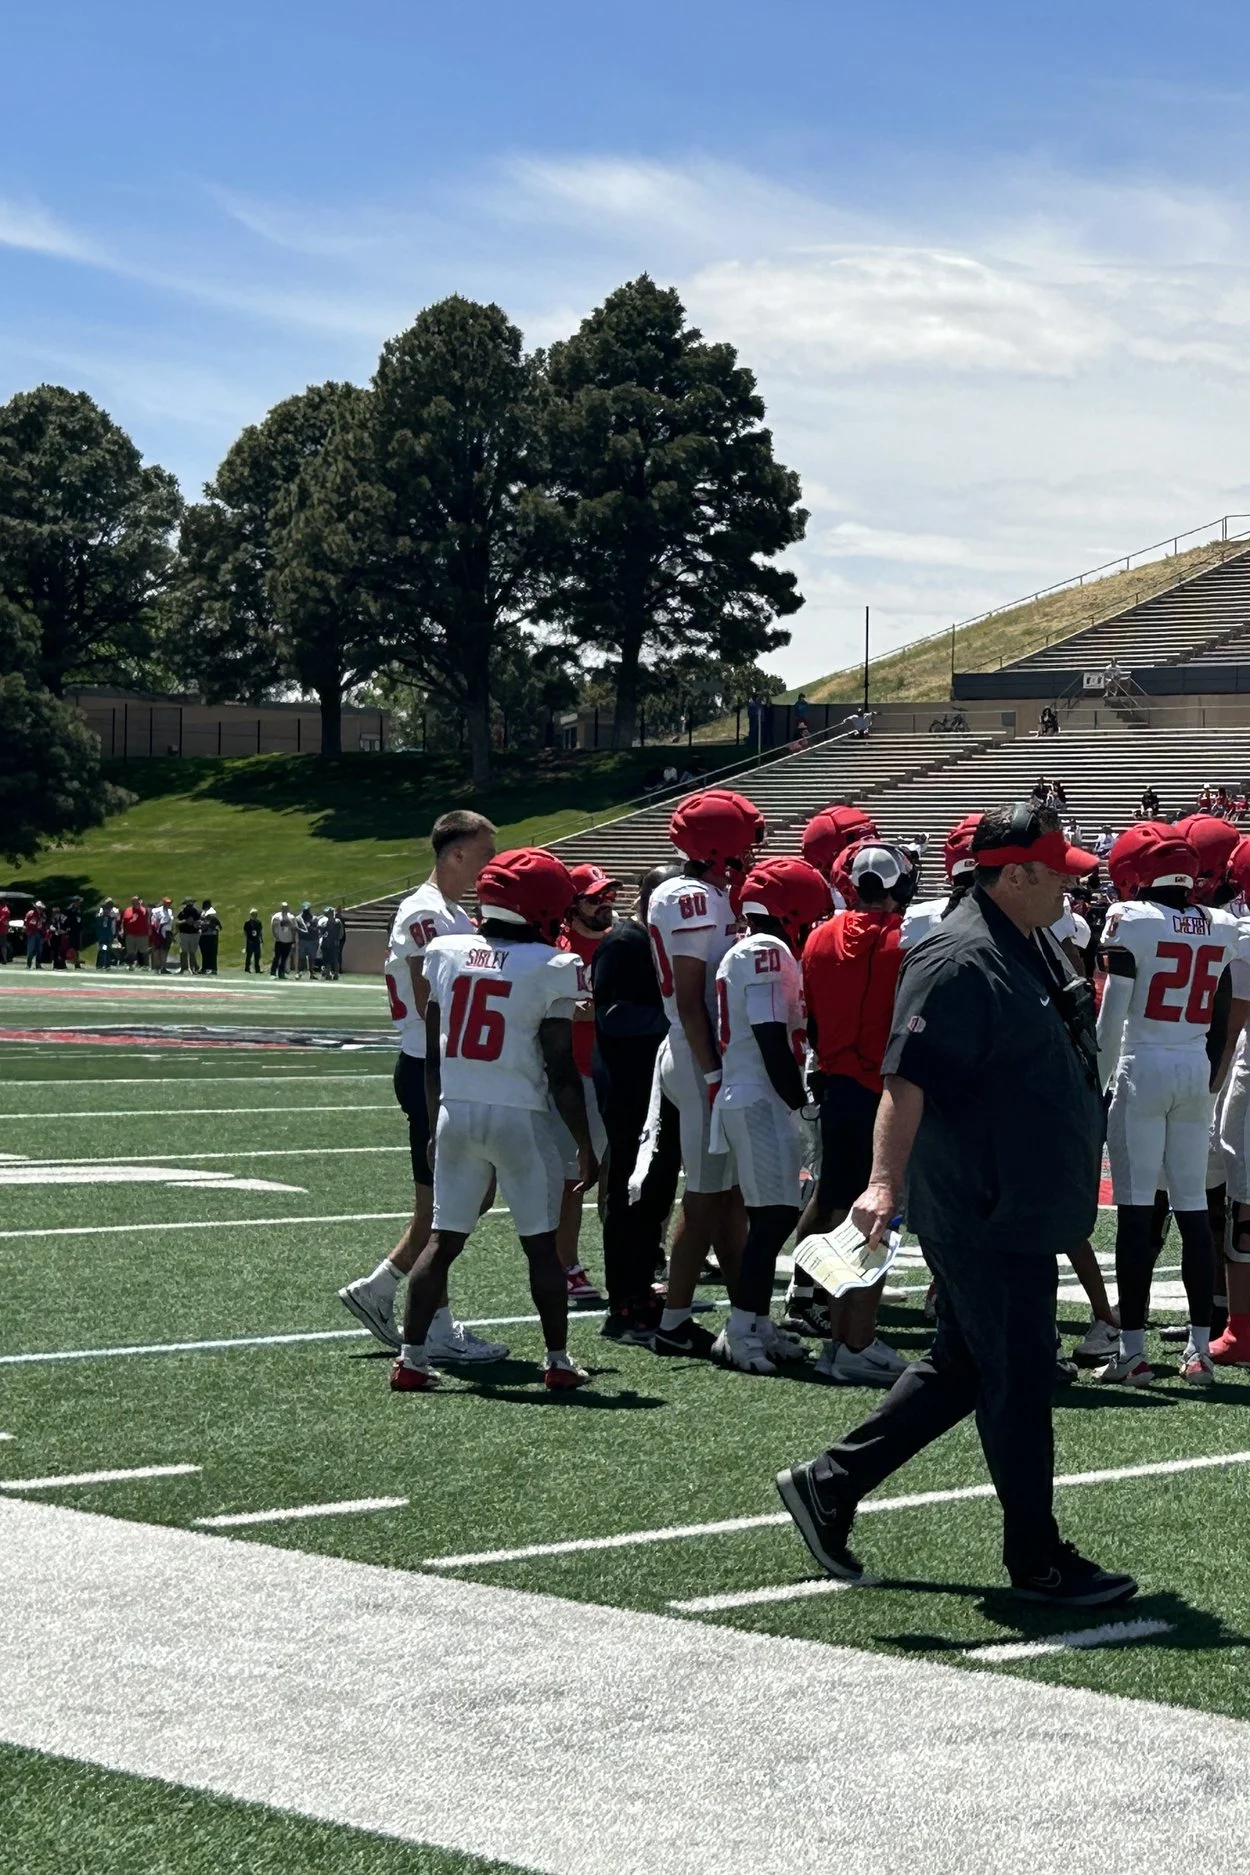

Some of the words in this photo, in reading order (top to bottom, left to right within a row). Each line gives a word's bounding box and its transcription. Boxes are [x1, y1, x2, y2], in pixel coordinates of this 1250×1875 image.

[678, 892, 708, 920] 80
[465, 948, 510, 971] SIBLEY
[754, 948, 781, 975] 20
[1144, 941, 1226, 1024] 26
[445, 975, 513, 1062] 16
